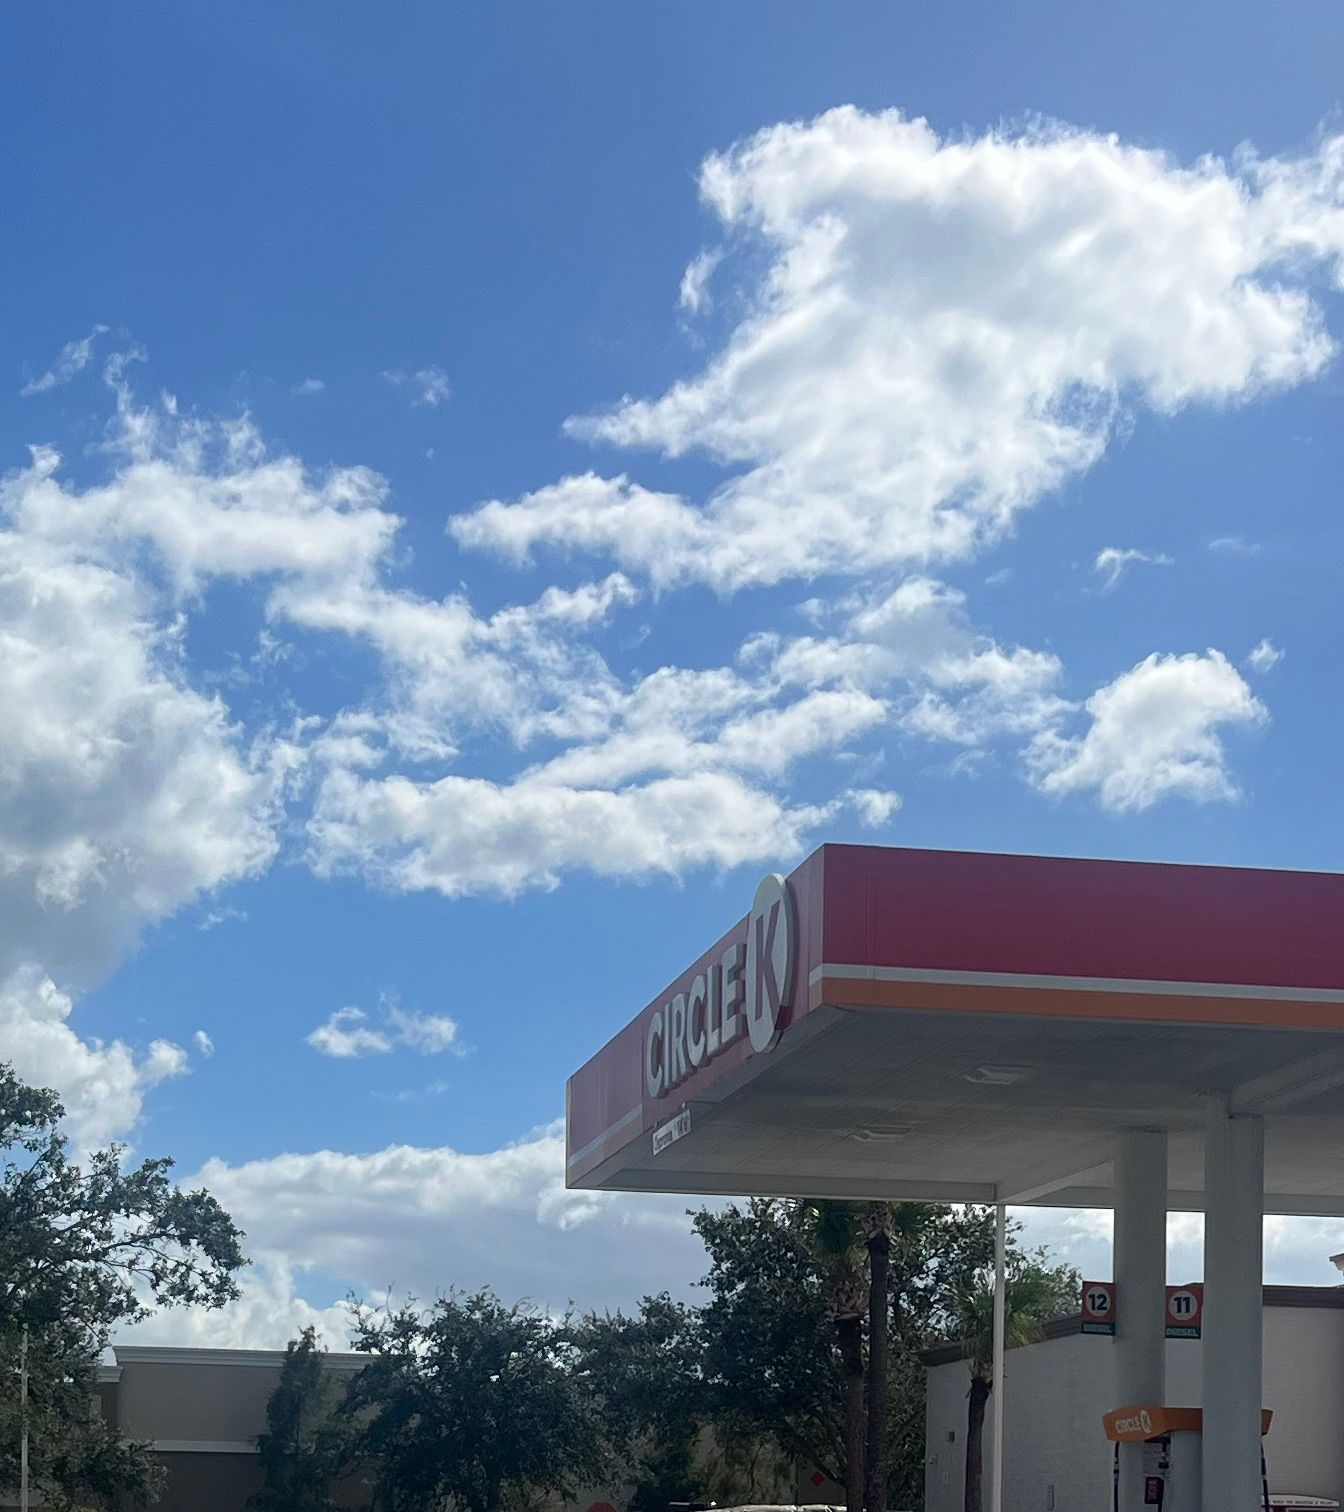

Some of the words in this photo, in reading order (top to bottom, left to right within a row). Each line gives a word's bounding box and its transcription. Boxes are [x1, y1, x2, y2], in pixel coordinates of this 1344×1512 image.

[646, 943, 741, 1098] CIRCLE
[1088, 1294, 1108, 1311] 12
[1174, 1296, 1191, 1313] 11
